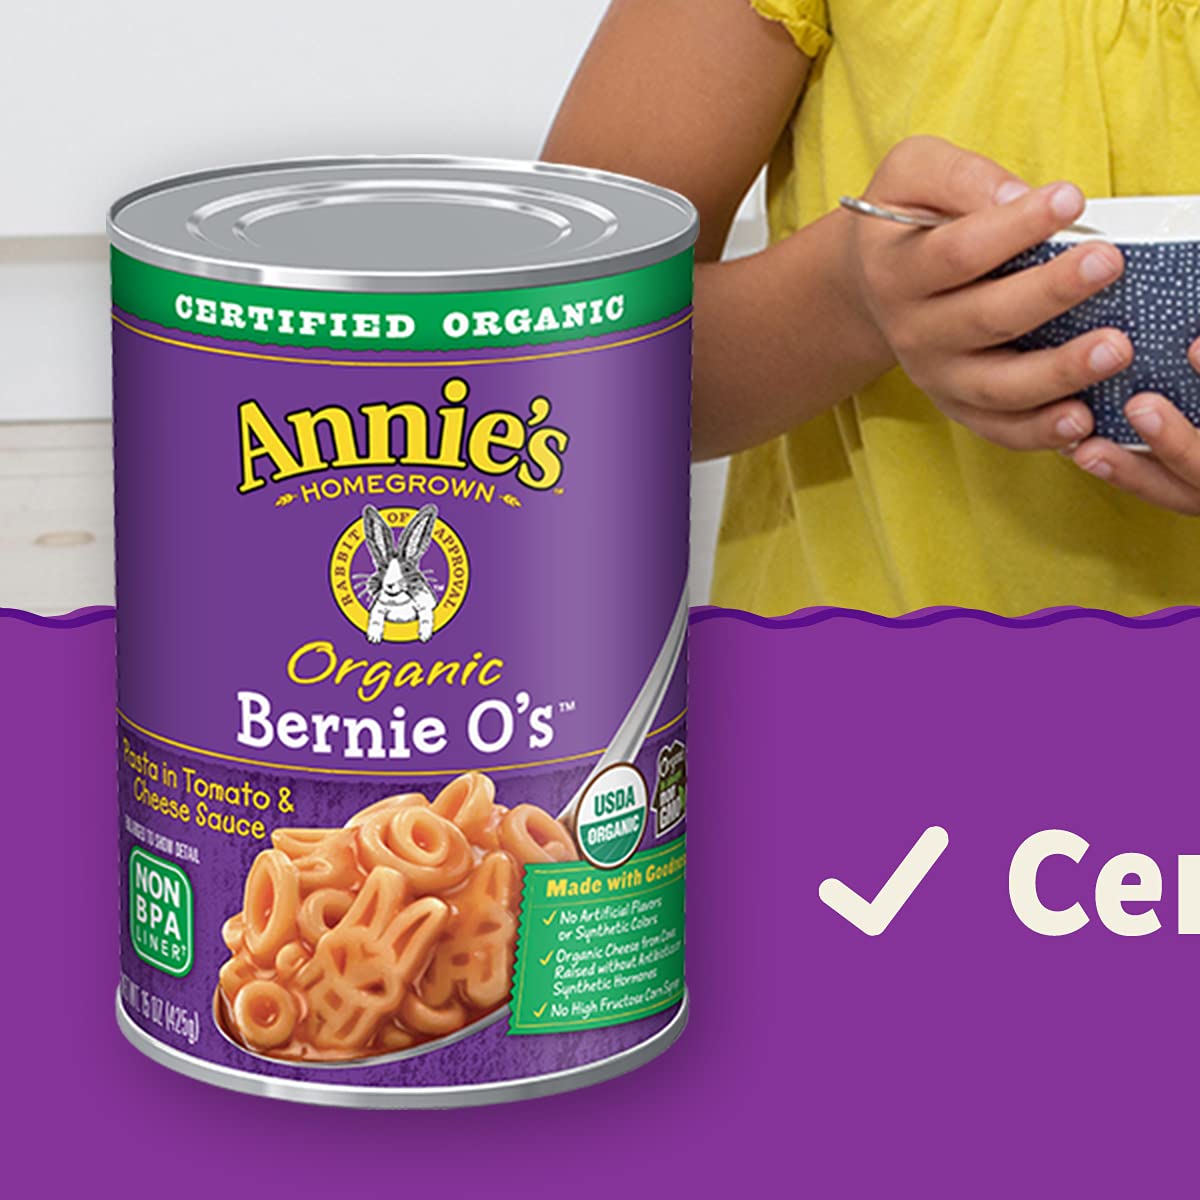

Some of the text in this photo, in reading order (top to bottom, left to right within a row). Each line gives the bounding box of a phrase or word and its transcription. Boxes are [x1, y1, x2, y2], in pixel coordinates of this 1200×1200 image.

[175, 294, 625, 339] CERTIFIED ORGANIC
[237, 376, 570, 492] Annie's
[300, 473, 496, 504] HOMEGROWN
[334, 511, 466, 610] RABBIT OF APPROVAL
[286, 640, 505, 703] Organic
[236, 691, 448, 759] Bernie
[122, 737, 295, 814] Pasta in Tomato &
[133, 775, 267, 840] Cheese Sauce
[594, 784, 637, 818] USDA
[587, 813, 641, 847] ORGANIC
[135, 861, 181, 909] NON
[546, 877, 602, 898] Made
[607, 868, 642, 892] with
[135, 894, 181, 942] BPA
[559, 909, 578, 925] No
[579, 903, 630, 922] Artificial
[557, 929, 574, 942] or
[575, 921, 629, 944] Synthetic
[554, 962, 596, 980] Raised
[555, 946, 603, 968] Organic
[552, 977, 612, 999] Synthetic
[551, 1003, 569, 1018] No
[571, 1001, 598, 1020] High
